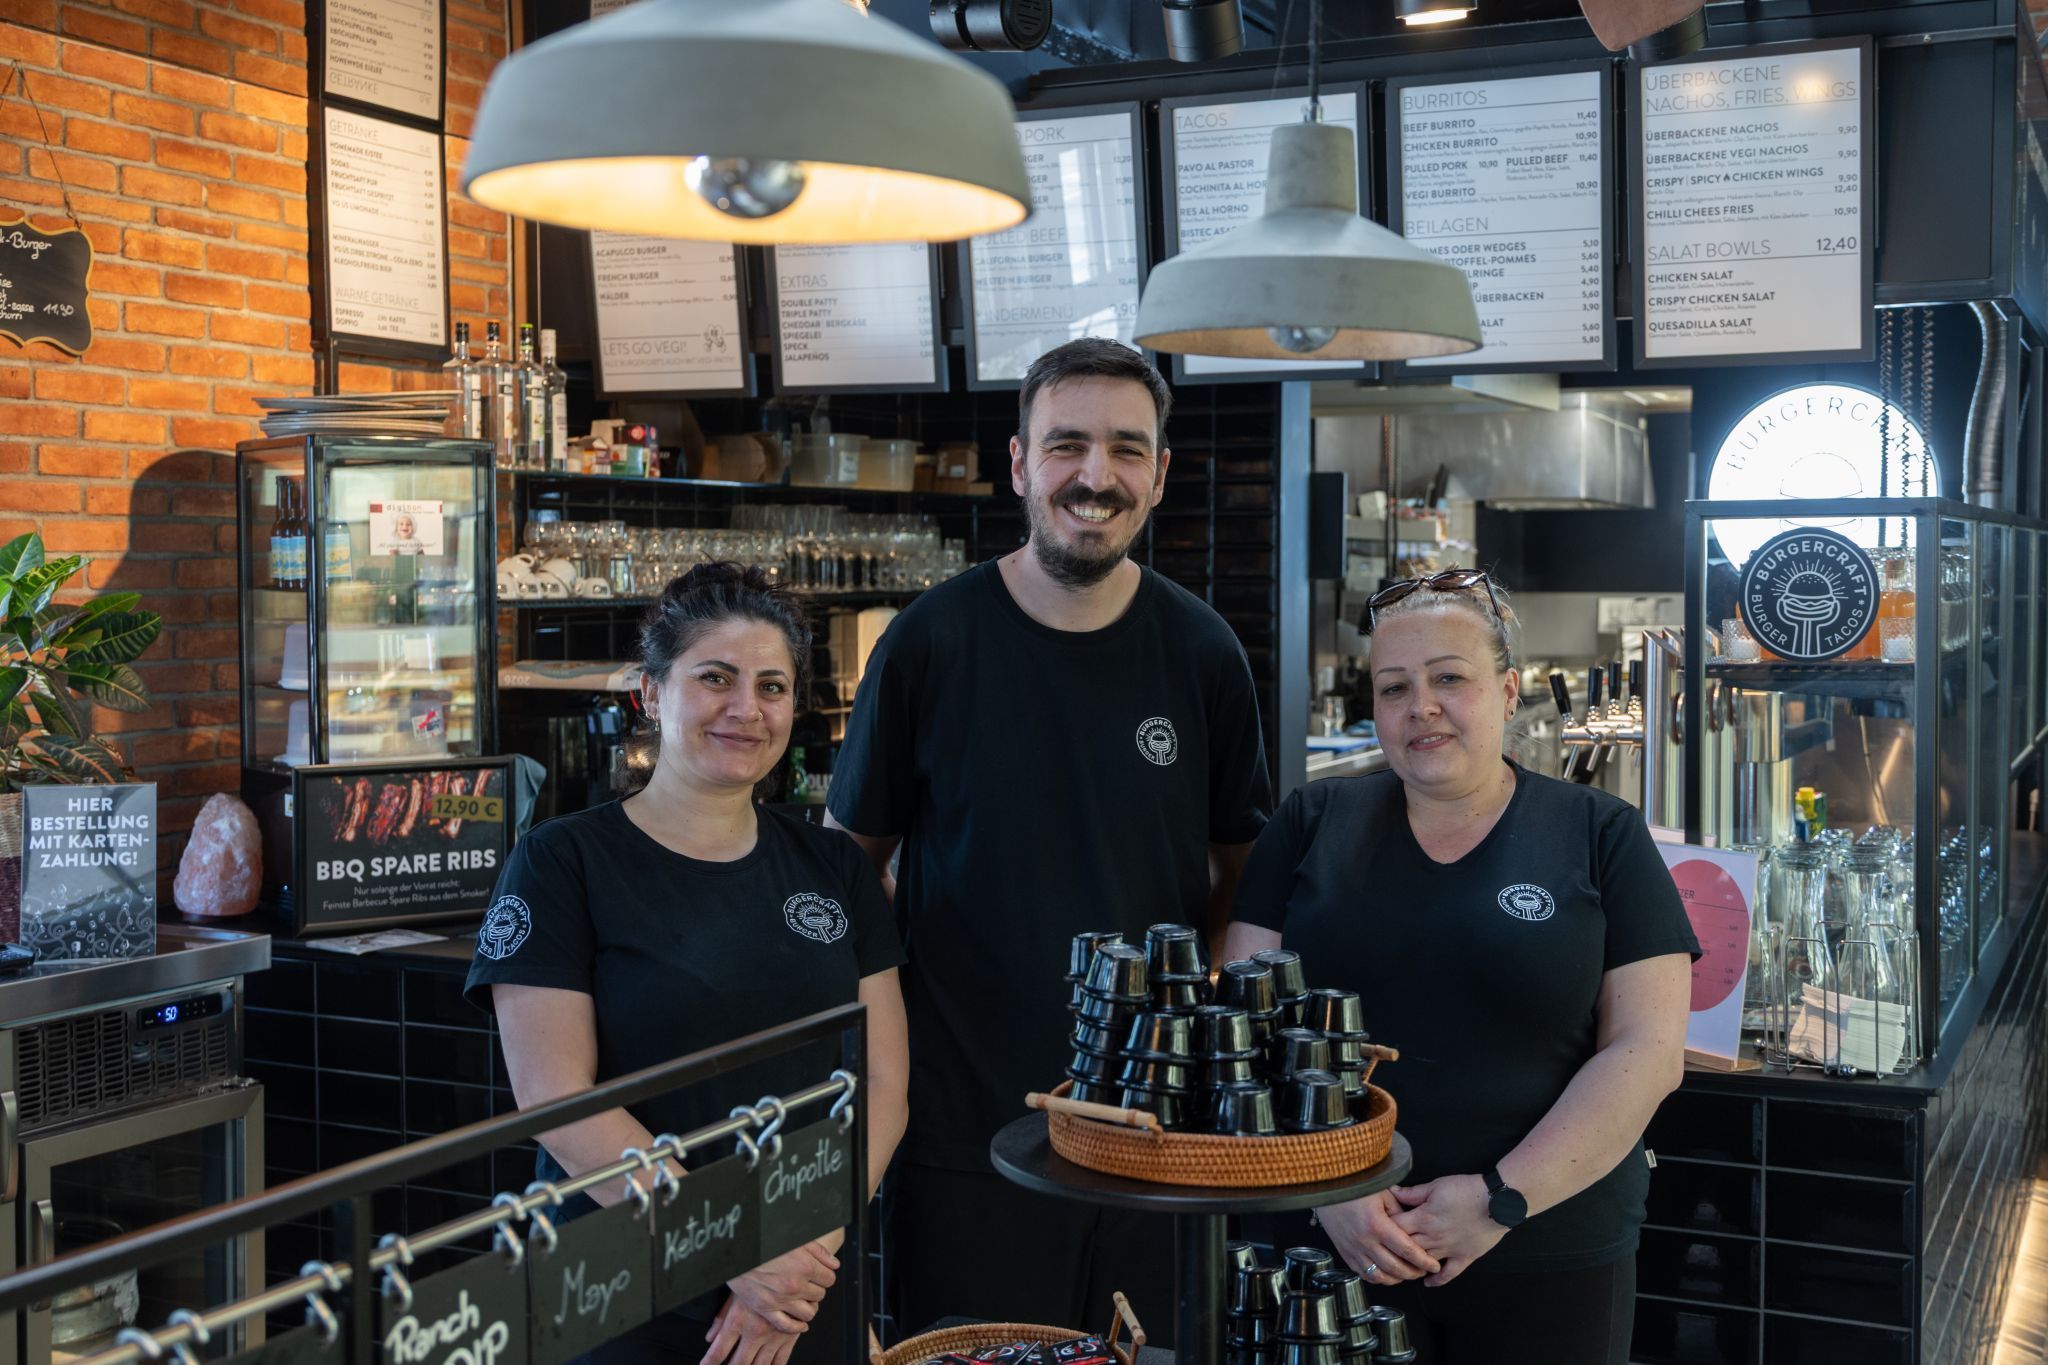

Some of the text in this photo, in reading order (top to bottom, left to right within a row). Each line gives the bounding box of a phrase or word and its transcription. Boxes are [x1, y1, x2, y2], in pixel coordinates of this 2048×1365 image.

[1645, 64, 1781, 90] ÜBERBACKENE
[1403, 90, 1488, 111] BURRITOS
[1646, 92, 1730, 113] NACHOS,
[1734, 87, 1789, 104] FRIES,
[1177, 112, 1228, 130] TACOS
[1403, 122, 1429, 133] BEEF
[1430, 119, 1476, 131] BURRITO
[1577, 111, 1597, 121] 11,40
[1025, 127, 1065, 143] PORK
[1646, 126, 1727, 142] ÜBERBACKENE
[1729, 122, 1779, 134] NACHOS
[1838, 125, 1857, 135] 9,90
[1404, 141, 1450, 152] CHICKEN
[1452, 137, 1498, 149] BURRITO
[1576, 131, 1597, 141] 10,90
[1646, 149, 1727, 165] ÜBERBACKENE
[1729, 147, 1757, 159] VEGI
[1759, 144, 1809, 155] NACHOS
[1838, 149, 1857, 160] 9,90
[1178, 159, 1254, 173] PAVO AL PASTOR
[1404, 153, 1597, 173] PULLED PORK 10,90 PULLED BEEF 11,40
[1646, 167, 1857, 188] CRISPY SPICY CHICKEN WINGS 9,90
[1179, 181, 1245, 195] COCHINITA AL
[1405, 189, 1429, 200] VEGI
[1431, 187, 1476, 198] BURRITO
[1576, 181, 1598, 190] 10,90
[1834, 183, 1858, 194] 12,40
[1180, 204, 1249, 216] RES AL HORNO
[1646, 208, 1682, 220] CHILLI
[1684, 206, 1720, 218] CHEES
[1723, 204, 1754, 215] FRIES
[1834, 207, 1858, 216] 10,90
[1180, 228, 1212, 238] BISTEC
[1405, 217, 1489, 235] BEILAGEN
[636, 245, 667, 255] BURGER
[1451, 239, 1599, 254] ODER WEDGES 5,10
[1647, 236, 1857, 261] SALAT BOWLS 12,40
[1028, 253, 1064, 263] BURGER
[1581, 251, 1599, 261] 5,60
[597, 271, 659, 282] FRENCH BURGER
[1581, 264, 1599, 273] 5,40
[780, 274, 828, 289] EXTRAS
[1017, 275, 1052, 283] BURGER
[1581, 277, 1599, 286] 4,90
[1648, 271, 1733, 284] CHICKEN SALAT
[781, 298, 837, 308] DOUBLE PATTY
[1475, 290, 1599, 303] ÜBERBACKEN 5,60
[1648, 291, 1775, 307] CRISPY CHICKEN SALAT
[781, 309, 832, 318] TRIPLE PATTY
[1582, 302, 1600, 312] 3,90
[782, 321, 820, 329] CHEDDAR
[1480, 318, 1600, 331] ALAT 5,60
[1648, 317, 1752, 332] QUESADILLA SALAT
[783, 331, 821, 340] SPIEGELEI
[632, 342, 652, 355] GO
[783, 342, 808, 350] SPECK
[1756, 540, 1867, 595] BURGERCRAFT
[1751, 593, 1864, 648] BURGER TACOS
[68, 797, 113, 812] HIER
[435, 799, 498, 818] 12,90 €
[31, 815, 149, 832] BESTELLUNG
[29, 832, 149, 850] MIT KARTEN-
[40, 851, 138, 868] ZAHLUNG!
[316, 849, 497, 882] BBQ SPARE RIBS
[353, 886, 369, 896] Nur
[370, 884, 399, 897] solange
[399, 882, 412, 892] der
[412, 880, 436, 891] Vorrat
[323, 887, 489, 910] Feinste Barbecue Spare Ribs aus dem Smoker!
[764, 1138, 843, 1204] Chipotle
[663, 1200, 741, 1270] Ketchup
[554, 1260, 631, 1325] Mayo
[384, 1289, 480, 1364] Ranch
